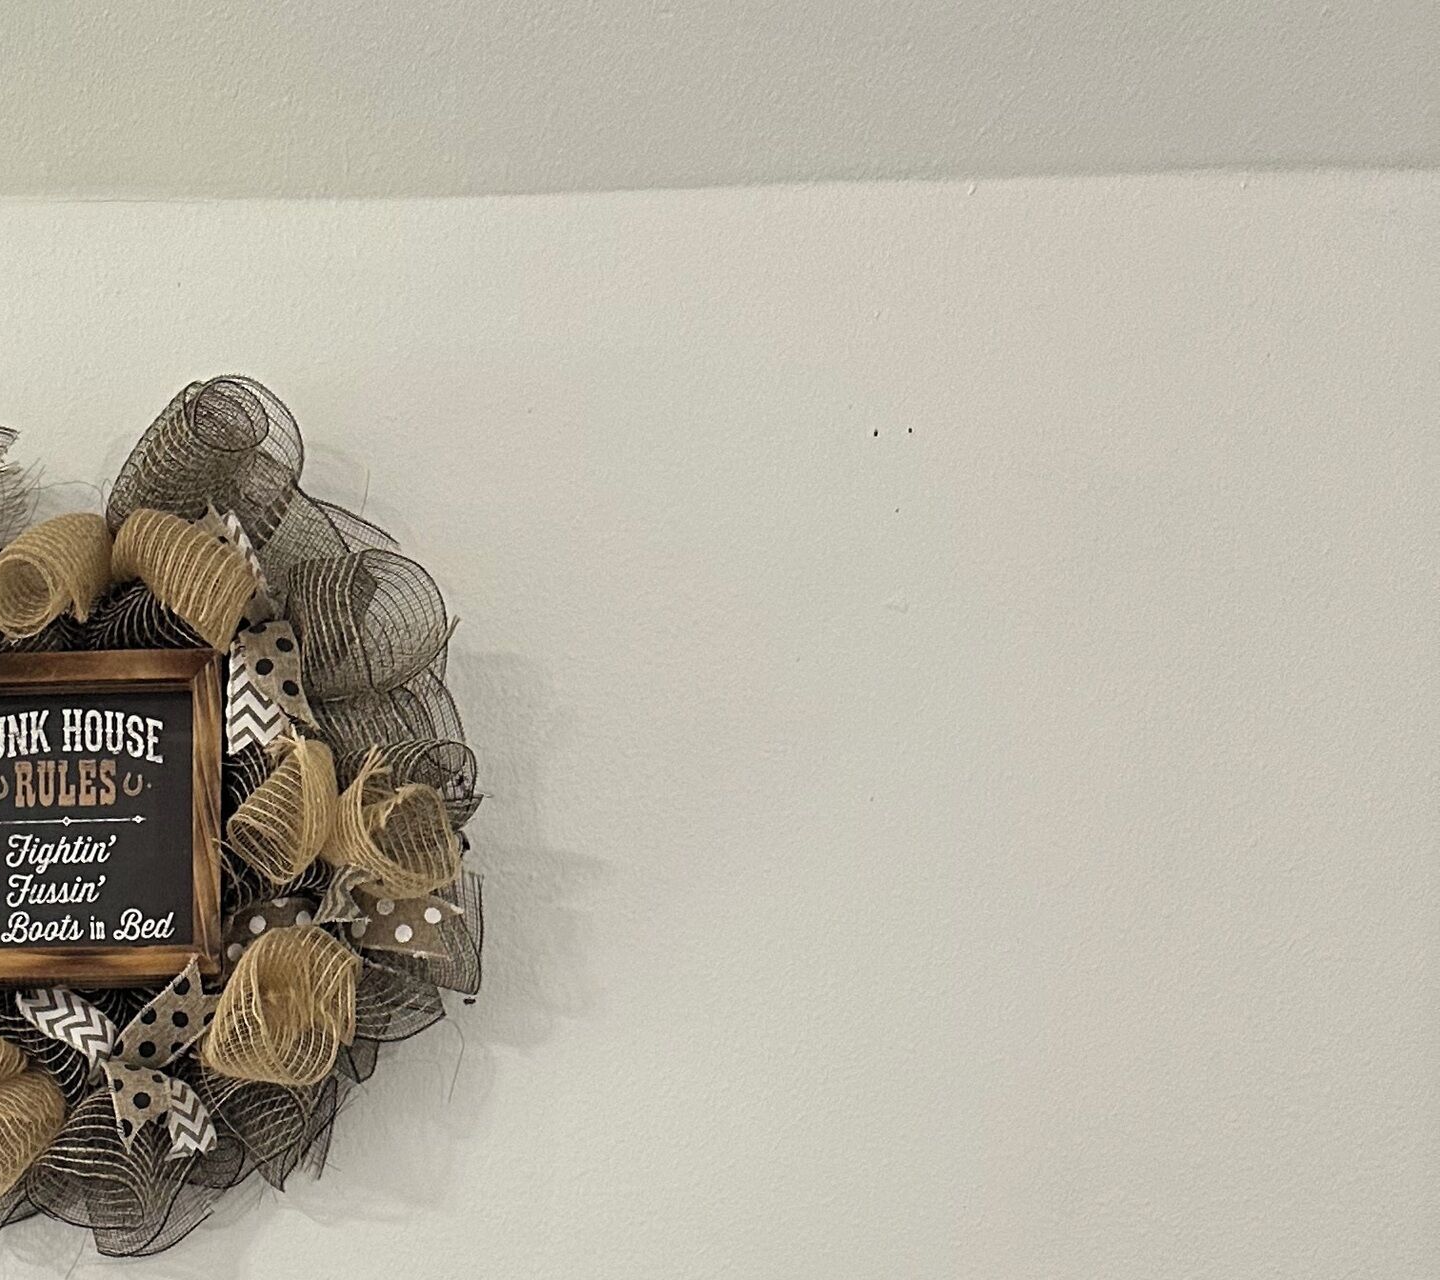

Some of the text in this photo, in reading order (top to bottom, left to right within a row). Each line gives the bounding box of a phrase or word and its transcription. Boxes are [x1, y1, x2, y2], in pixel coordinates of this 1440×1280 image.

[61, 708, 165, 765] HOUSE
[14, 759, 118, 808] RULES
[0, 910, 85, 944] Boots
[89, 915, 106, 940] in
[112, 907, 175, 941] Bed
